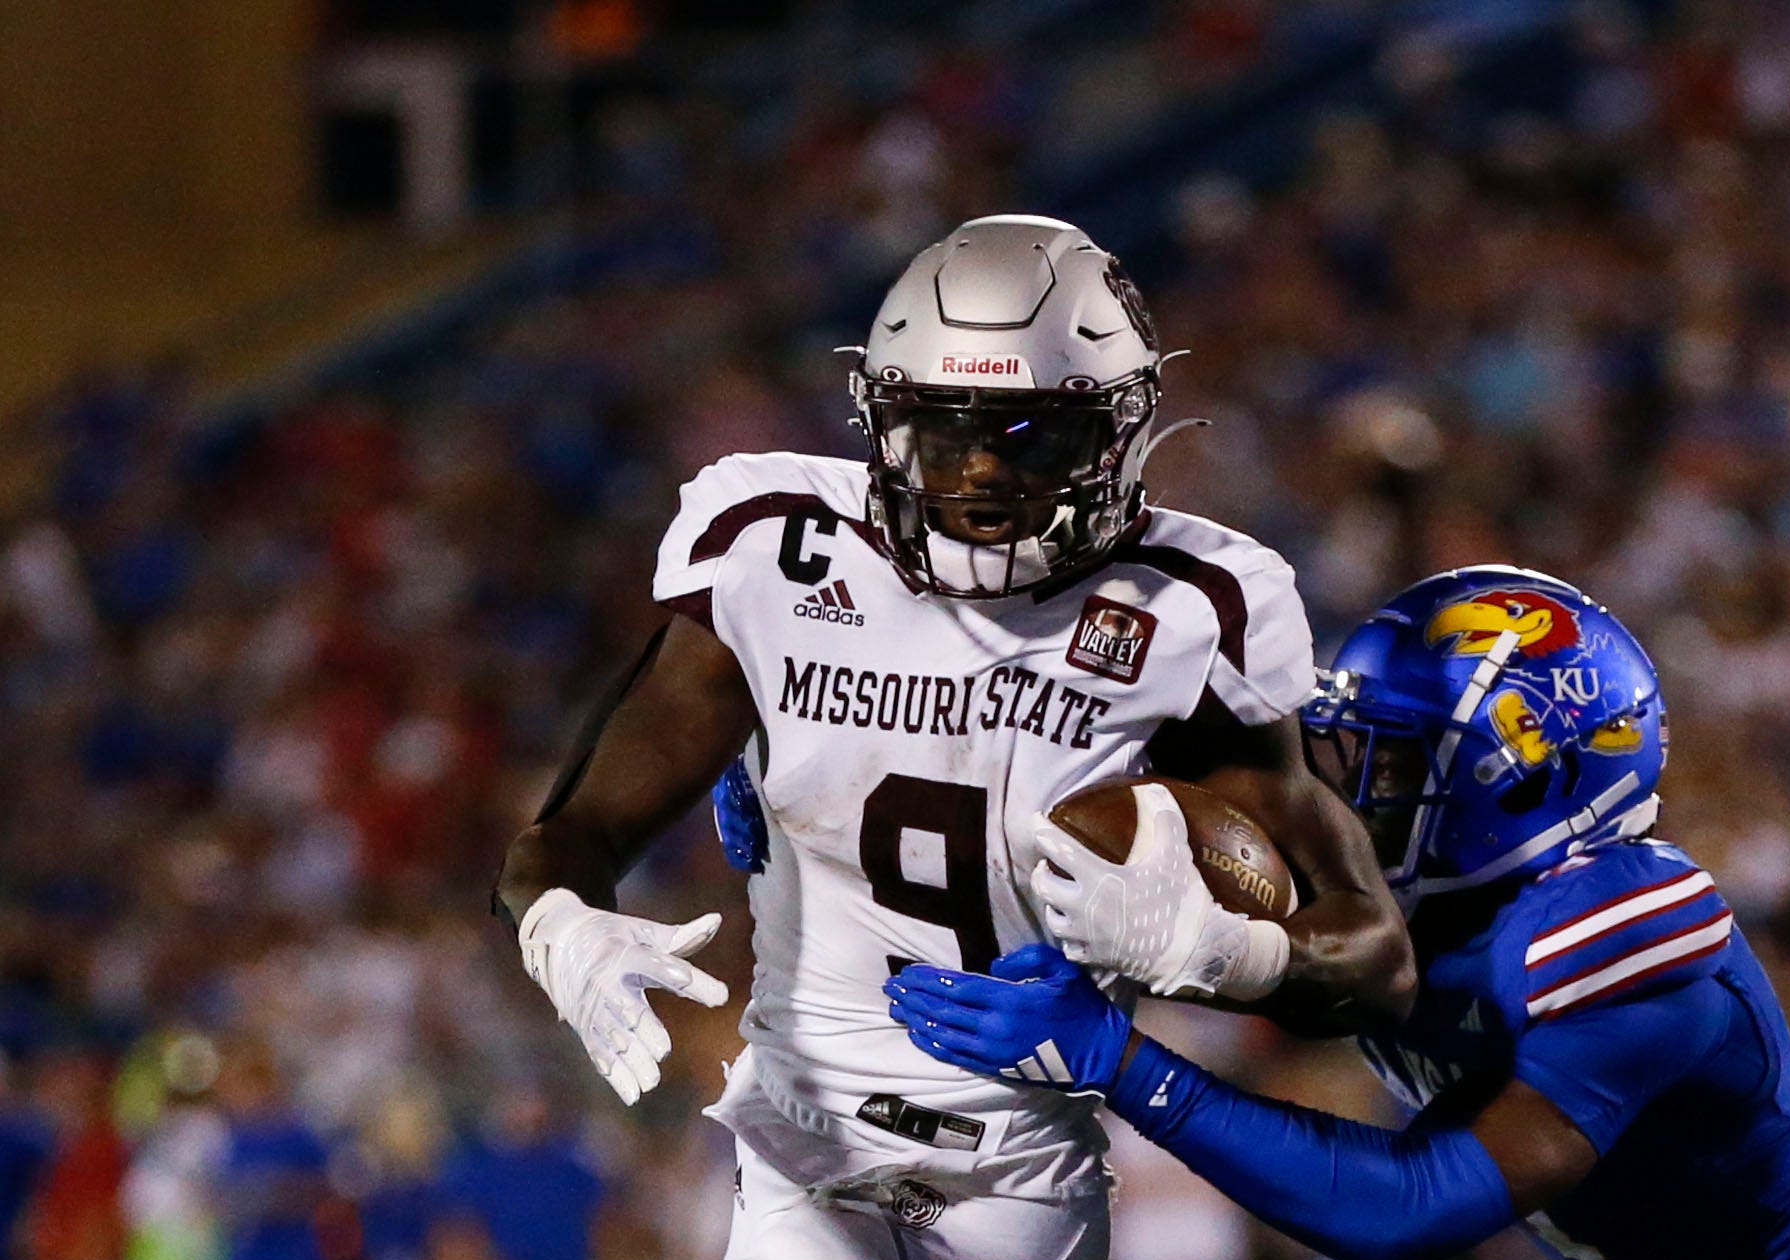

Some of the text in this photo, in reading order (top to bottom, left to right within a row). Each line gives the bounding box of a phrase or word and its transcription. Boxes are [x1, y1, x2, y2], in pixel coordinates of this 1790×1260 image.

[942, 357, 1019, 375] Riddell
[778, 505, 838, 587] C
[794, 603, 865, 627] adidas
[1078, 619, 1144, 665] VALLEY
[779, 656, 1112, 750] MISSOURI STATE
[1549, 667, 1600, 706] KU
[859, 772, 1001, 976] 9
[1203, 846, 1275, 911] Wilson
